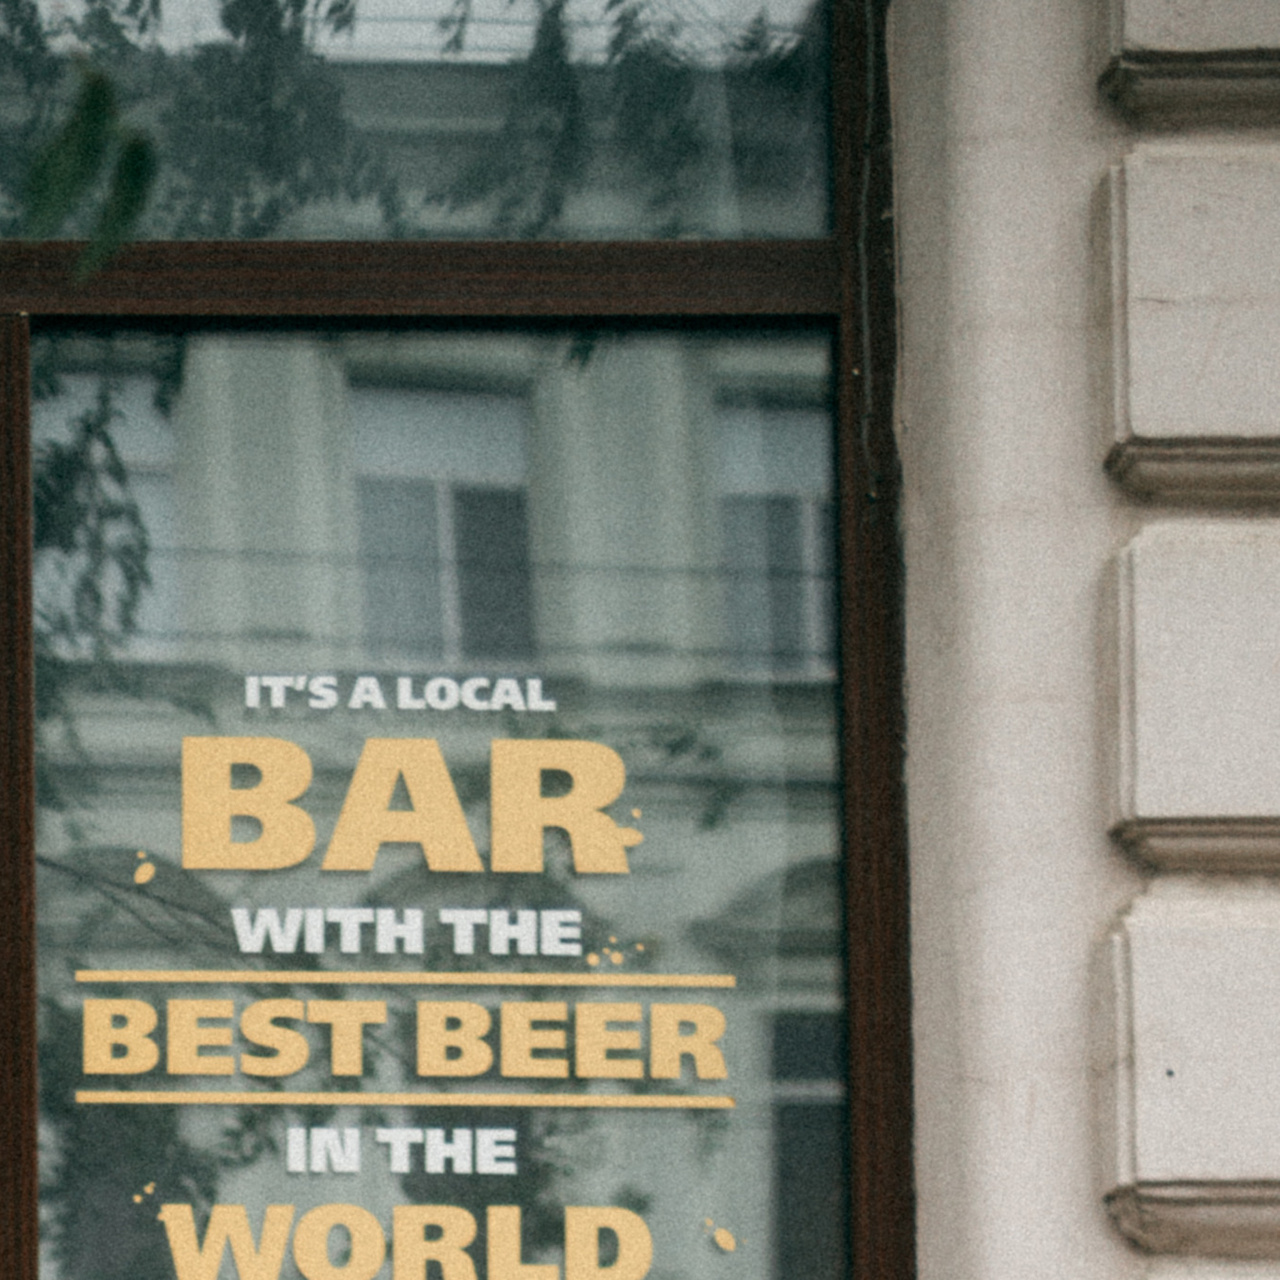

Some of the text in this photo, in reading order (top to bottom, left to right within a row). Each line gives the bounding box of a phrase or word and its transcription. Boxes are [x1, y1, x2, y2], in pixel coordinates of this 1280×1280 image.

[245, 675, 556, 711] IT'S A LOCAL
[181, 735, 631, 874] BAR
[231, 906, 582, 956] WITH THE
[82, 997, 729, 1080] BEST BEER
[286, 1125, 517, 1174] IN THE
